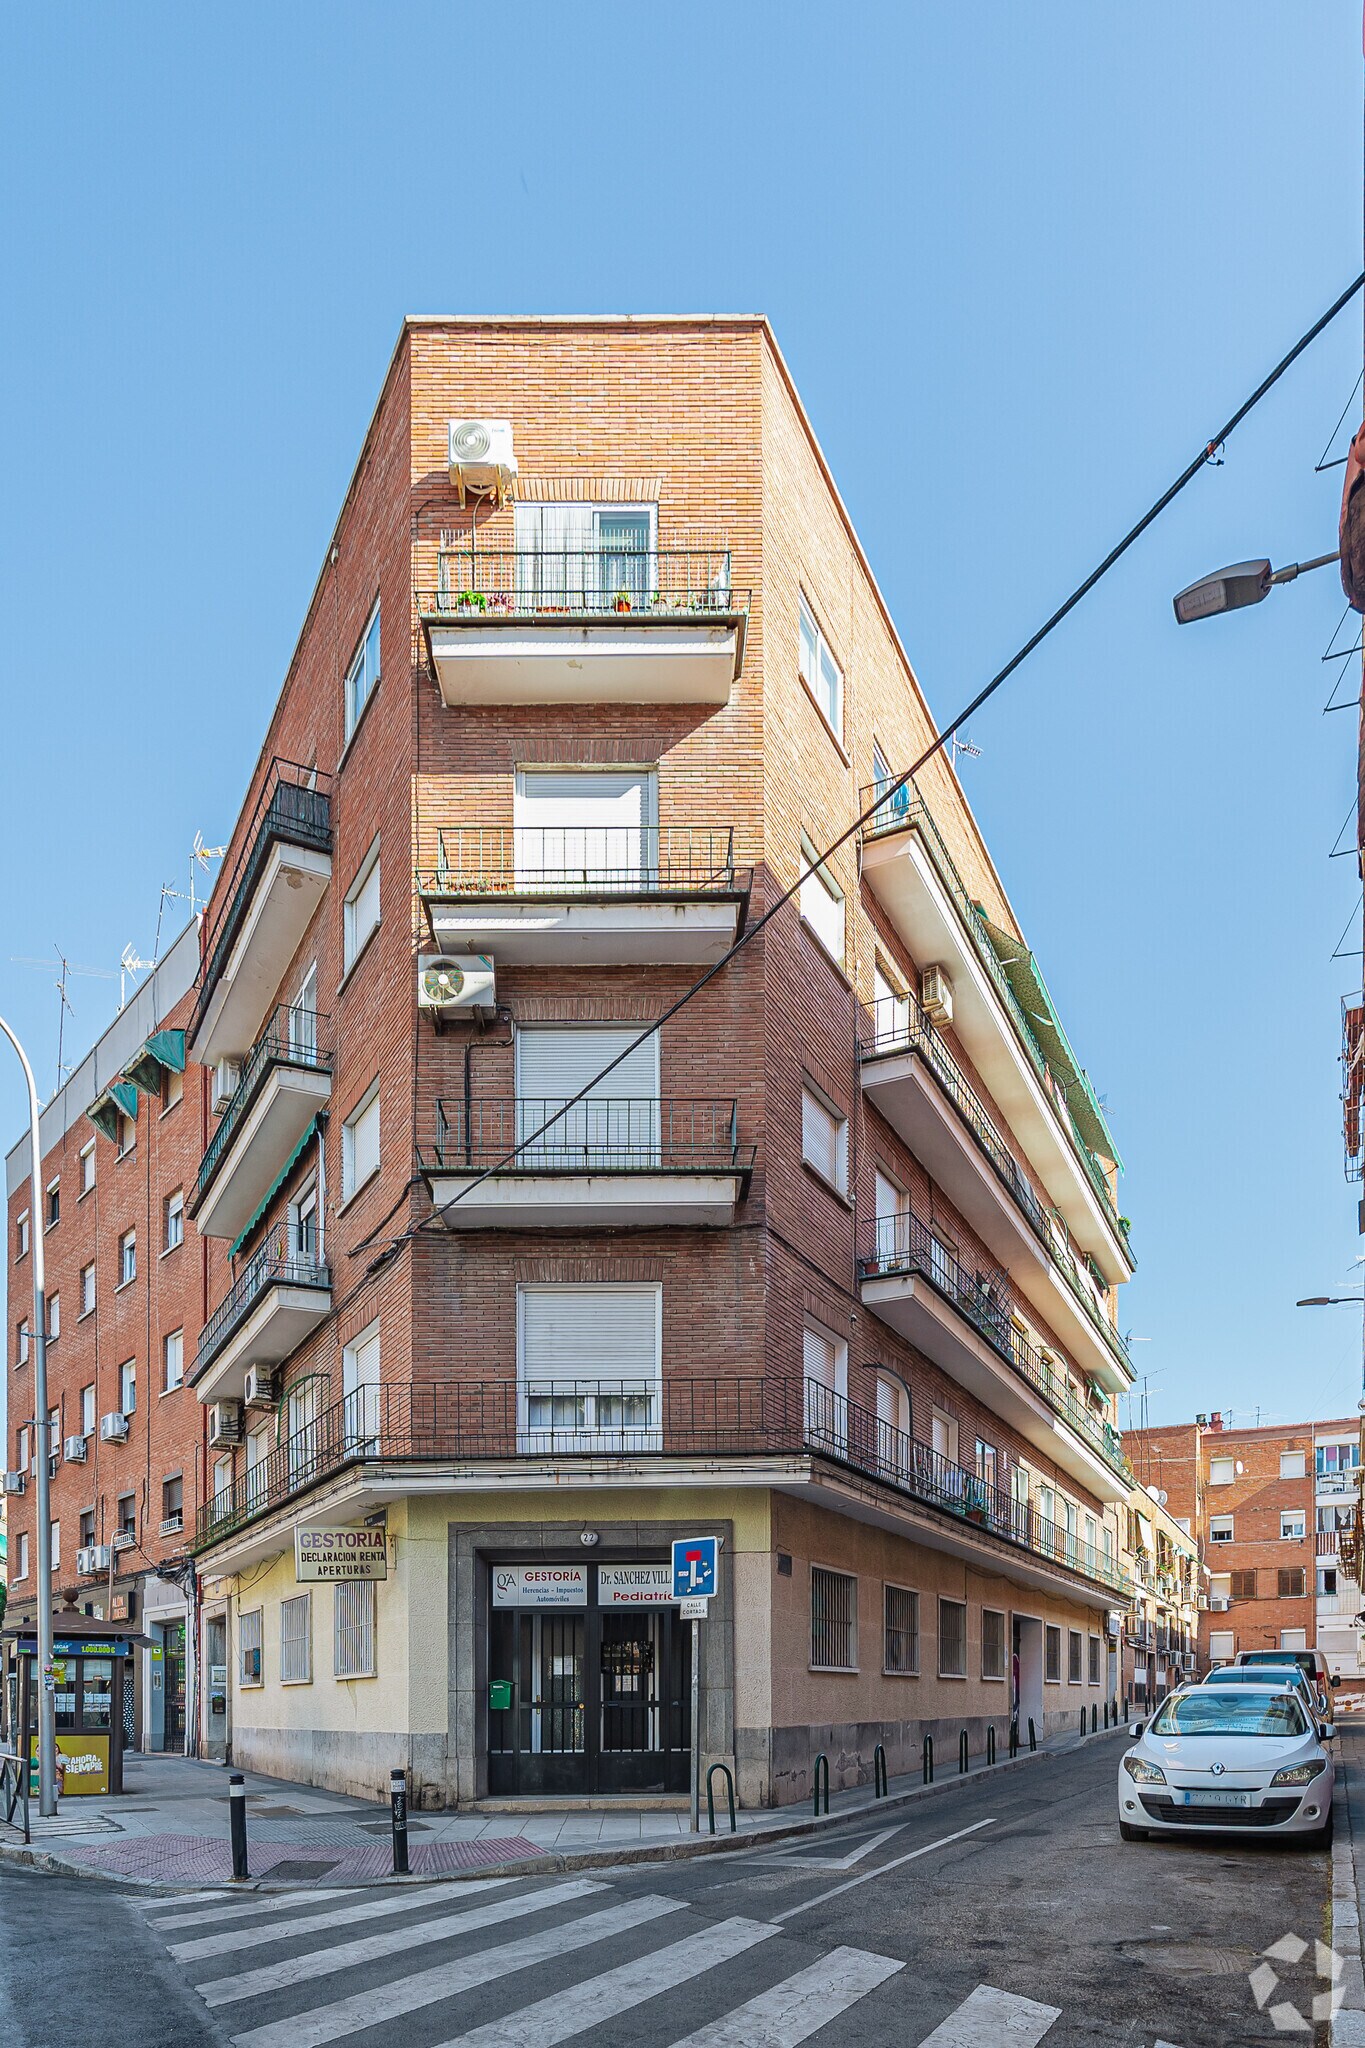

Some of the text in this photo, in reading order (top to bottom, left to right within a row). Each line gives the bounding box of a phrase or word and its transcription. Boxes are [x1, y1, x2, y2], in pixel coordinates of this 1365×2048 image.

[300, 1532, 384, 1548] GESTORIA
[583, 1533, 594, 1542] 22
[301, 1551, 385, 1562] DECLARACION RENTA
[317, 1565, 371, 1576] APERTURAS
[524, 1568, 581, 1581] GESTORÍA
[600, 1571, 612, 1585] Dr.
[613, 1570, 651, 1584] SANCHEZ
[652, 1570, 672, 1584] VILL
[556, 1586, 584, 1594] Impuestos
[65, 1761, 103, 1774] SIEMPRE
